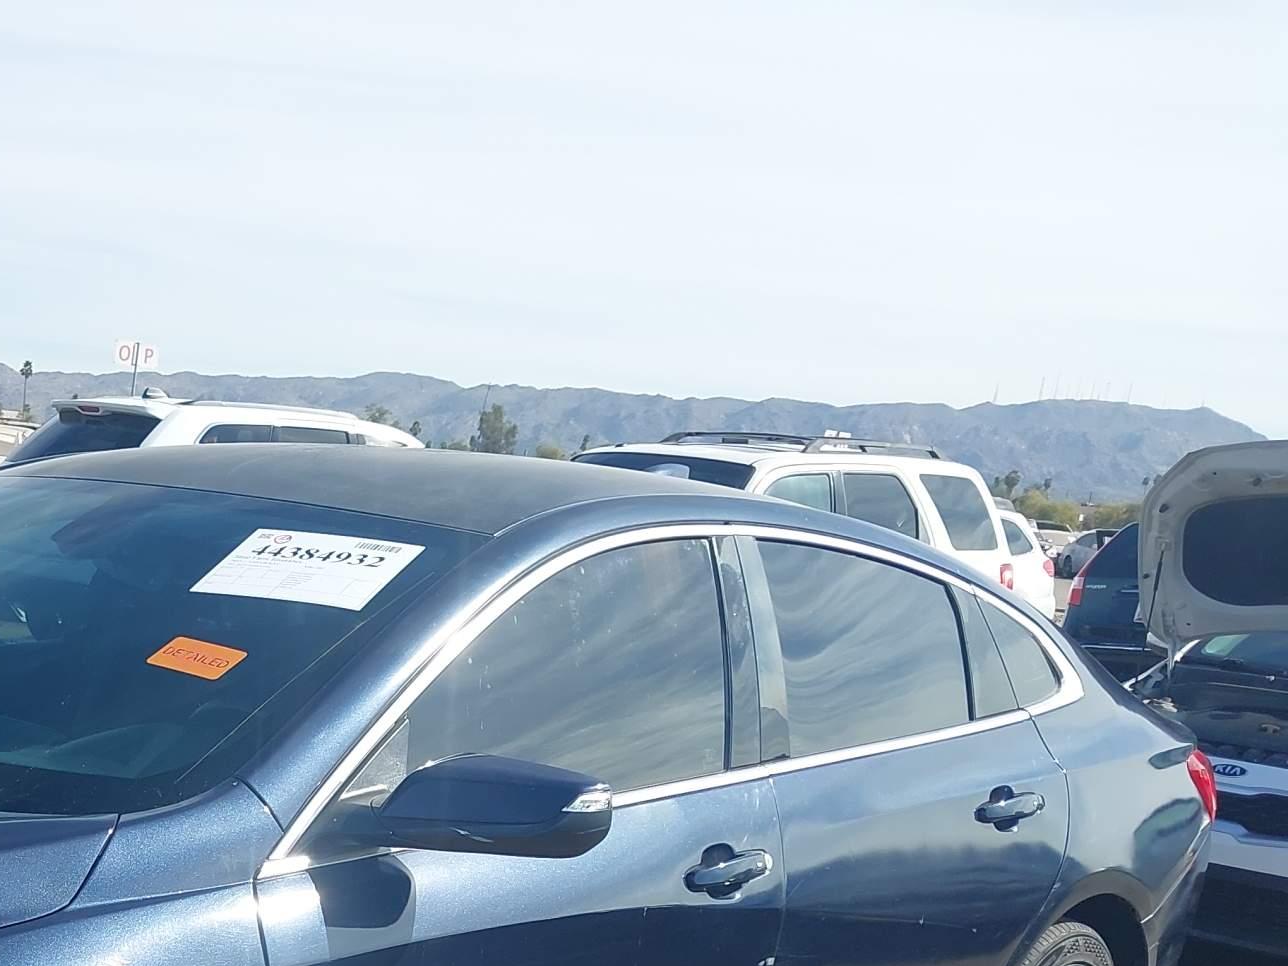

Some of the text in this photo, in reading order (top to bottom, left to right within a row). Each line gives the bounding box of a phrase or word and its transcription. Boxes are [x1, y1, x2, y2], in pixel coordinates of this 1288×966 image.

[144, 348, 154, 364] P
[252, 544, 386, 568] 44384932
[162, 646, 230, 669] DETAILED
[1214, 764, 1242, 776] KIA
